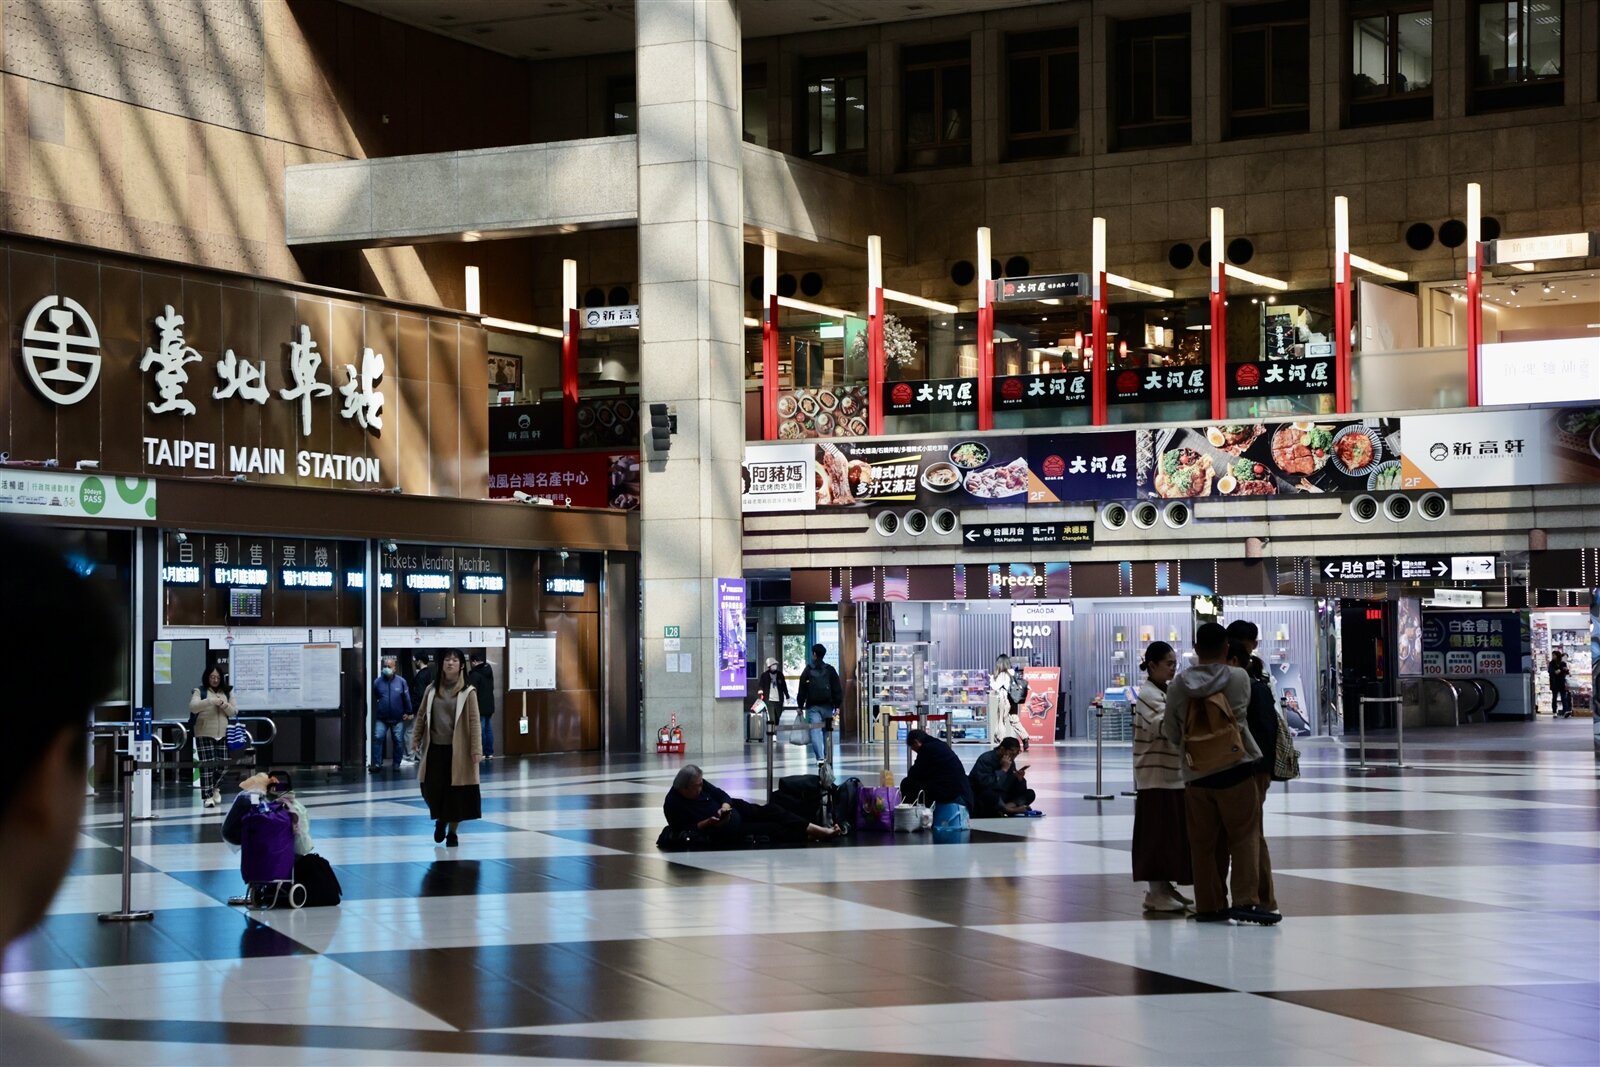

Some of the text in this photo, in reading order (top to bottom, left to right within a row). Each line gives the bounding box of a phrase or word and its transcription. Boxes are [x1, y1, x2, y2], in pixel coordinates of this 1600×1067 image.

[1017, 282, 1046, 293] 大河屋
[140, 305, 385, 436] 臺北車站
[1264, 362, 1328, 384] 大河屋
[1027, 376, 1085, 397] 大河屋
[1144, 369, 1204, 390] 大河屋
[916, 382, 972, 402] 大河屋
[507, 430, 541, 440] 新高軒
[1453, 439, 1525, 456] 新高軒
[143, 437, 380, 483] TAIPEI MAIN STATION
[1068, 455, 1127, 474] 大河屋
[752, 465, 803, 483] 阿豬媽
[871, 464, 919, 479] 韓式厚切
[856, 479, 916, 496] 多汁又滿足
[1404, 478, 1422, 487] 2F
[83, 495, 102, 503] PASS
[1030, 492, 1045, 501] 2F
[1032, 526, 1055, 535] 西一門
[179, 542, 329, 568] 自動售票機
[384, 553, 490, 571] Tickets Vending Machine
[1341, 561, 1363, 573] 月台
[992, 572, 1044, 587] Breeze
[665, 627, 679, 637] L28
[1013, 625, 1051, 637] CHAO
[1449, 619, 1503, 633] 白金會員
[1013, 638, 1033, 649] DA
[1449, 634, 1504, 648] 優惠升級
